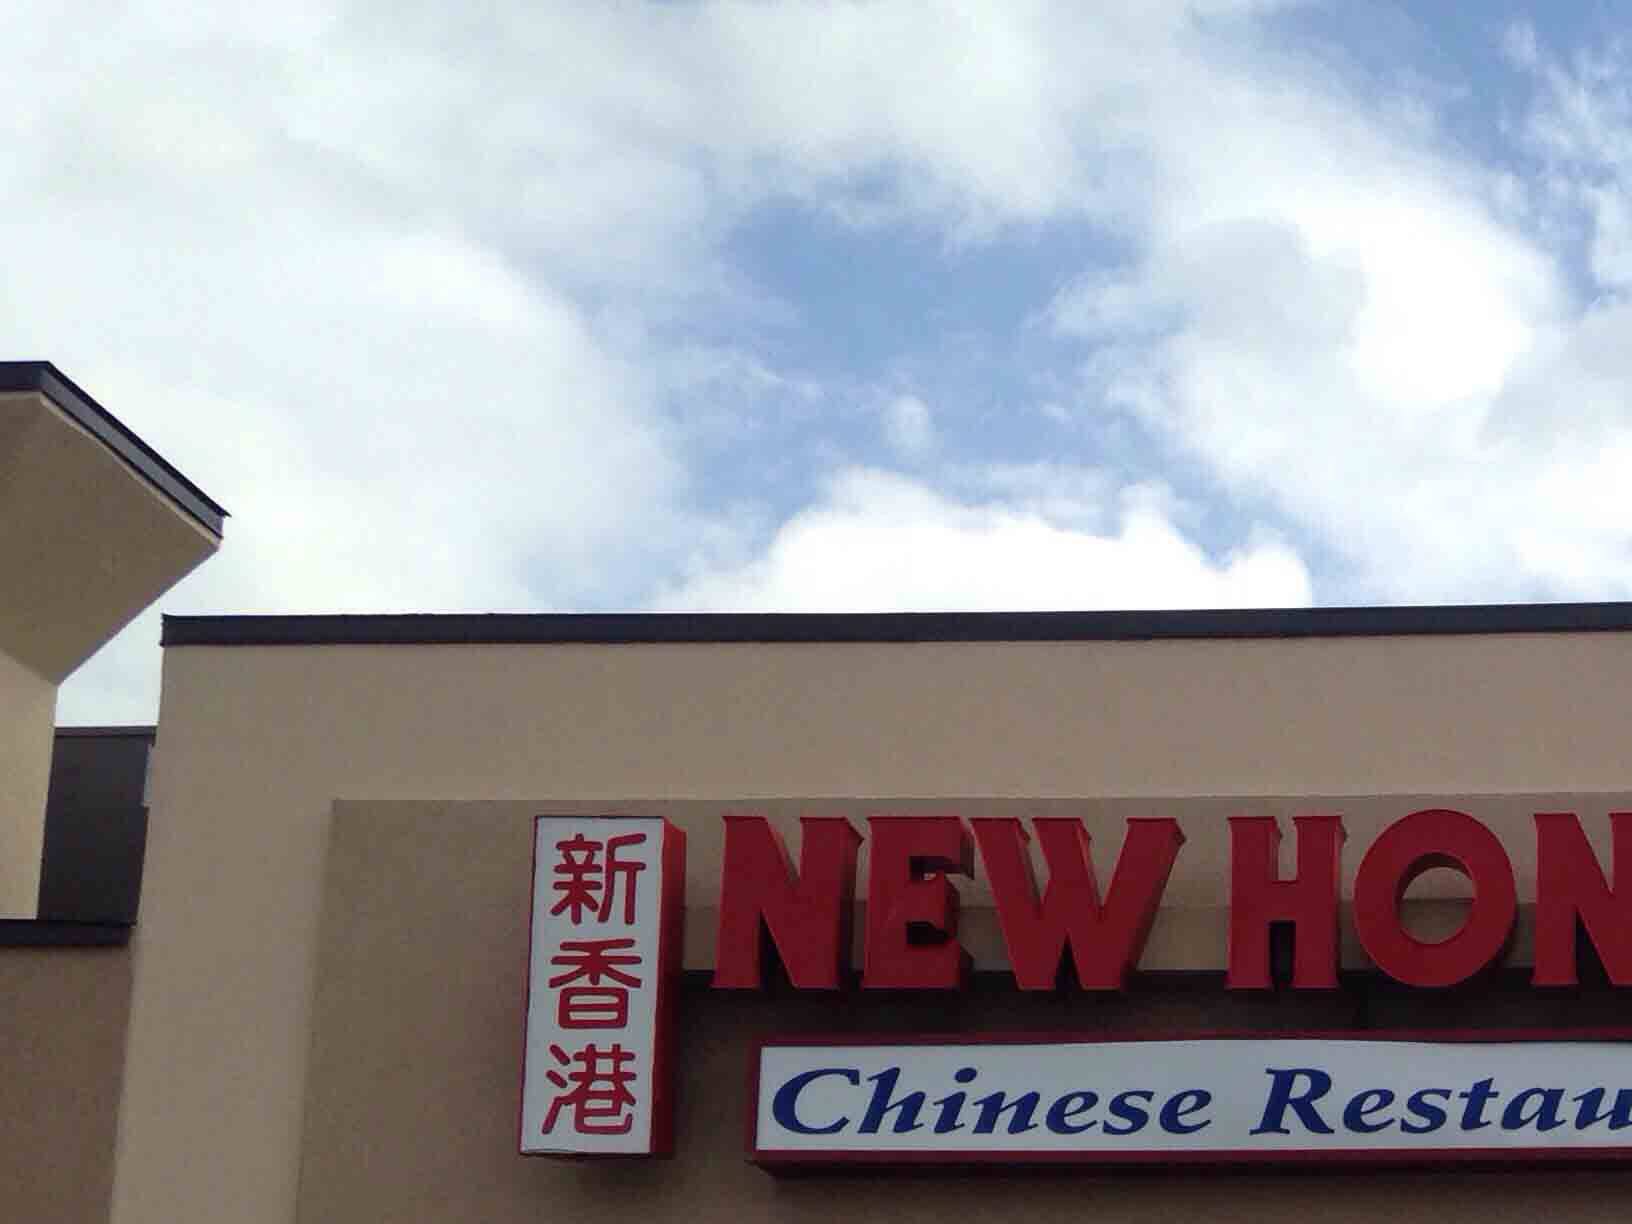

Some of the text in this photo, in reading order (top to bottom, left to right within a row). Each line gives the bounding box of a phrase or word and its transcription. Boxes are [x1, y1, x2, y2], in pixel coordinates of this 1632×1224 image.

[542, 831, 648, 1137] 新香港
[712, 815, 1186, 990] NEW
[770, 1066, 1213, 1136] Chinese
